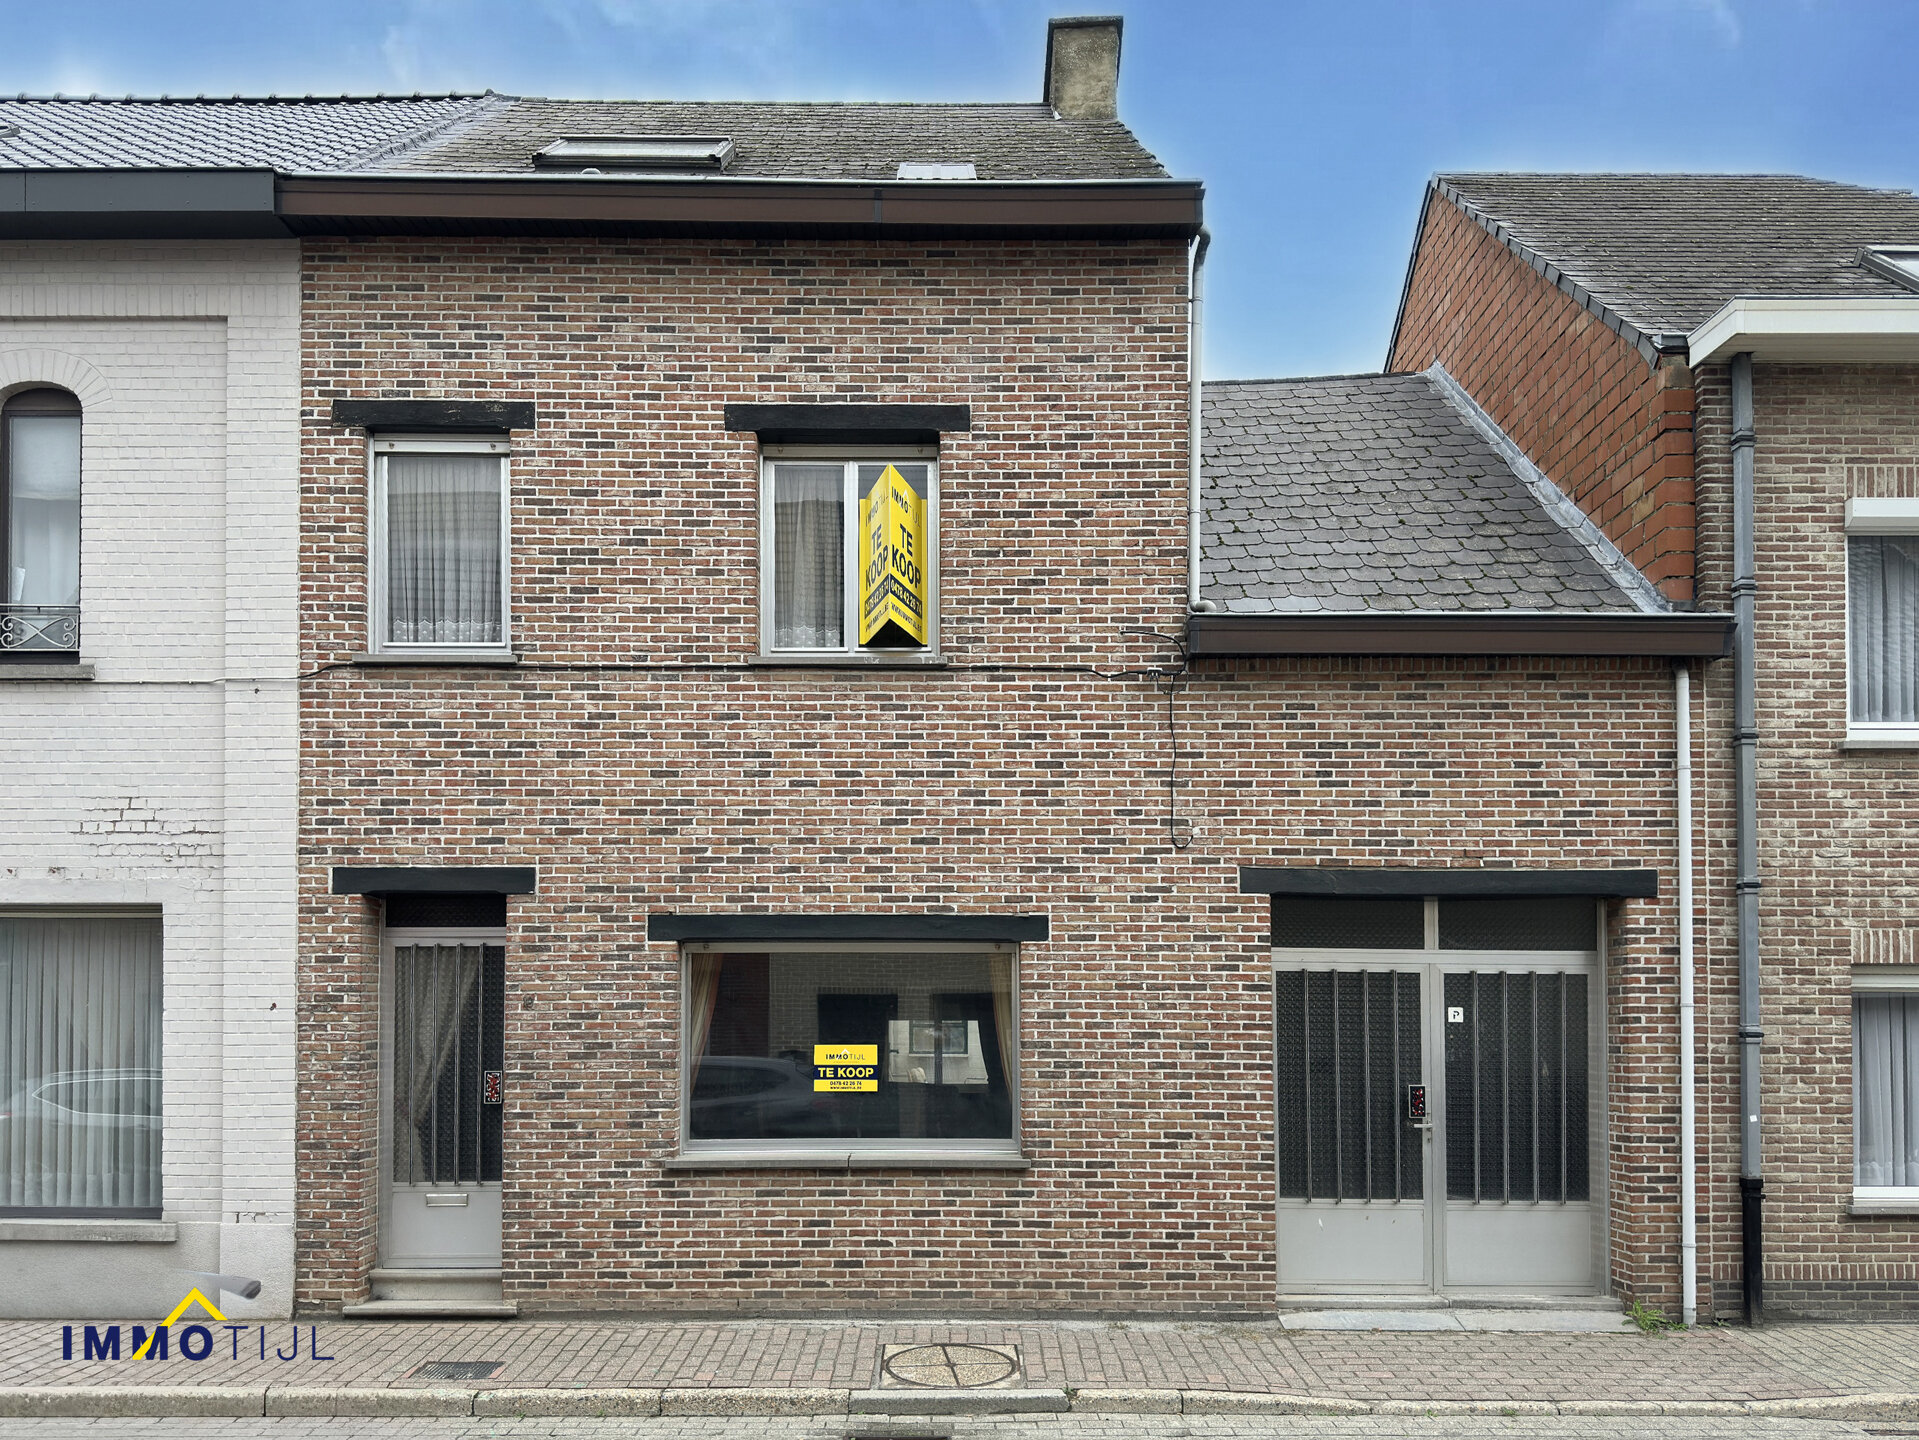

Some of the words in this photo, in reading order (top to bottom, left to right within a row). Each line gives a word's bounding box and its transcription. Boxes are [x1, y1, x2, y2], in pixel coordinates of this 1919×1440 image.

[871, 523, 882, 555] TE
[899, 522, 913, 557] TE
[865, 544, 888, 592] KOOP
[891, 543, 921, 589] KOOP
[818, 1067, 835, 1078] TE
[837, 1067, 874, 1078] KOOP
